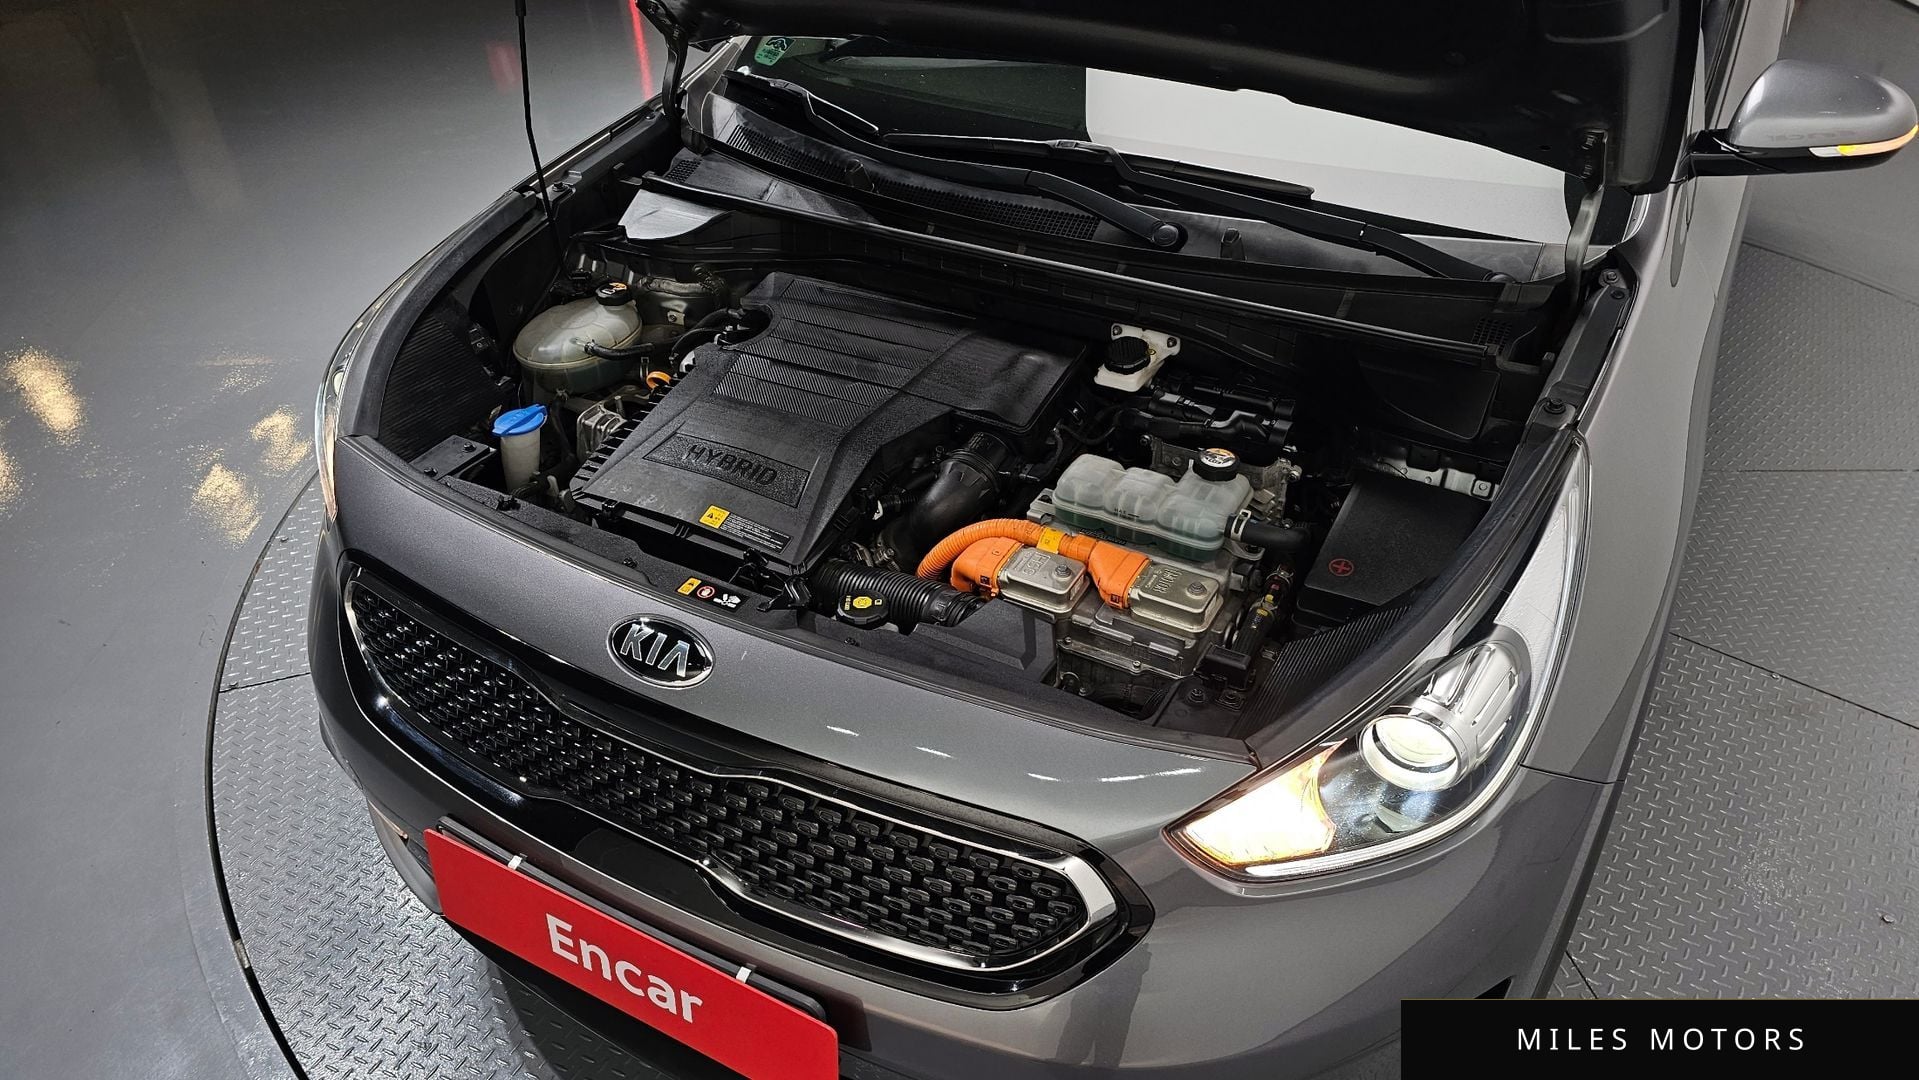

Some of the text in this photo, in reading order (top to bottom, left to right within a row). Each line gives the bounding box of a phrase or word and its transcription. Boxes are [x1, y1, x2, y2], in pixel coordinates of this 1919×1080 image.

[684, 444, 777, 486] HYBRID
[619, 622, 691, 678] KIA
[546, 913, 703, 1024] Encar
